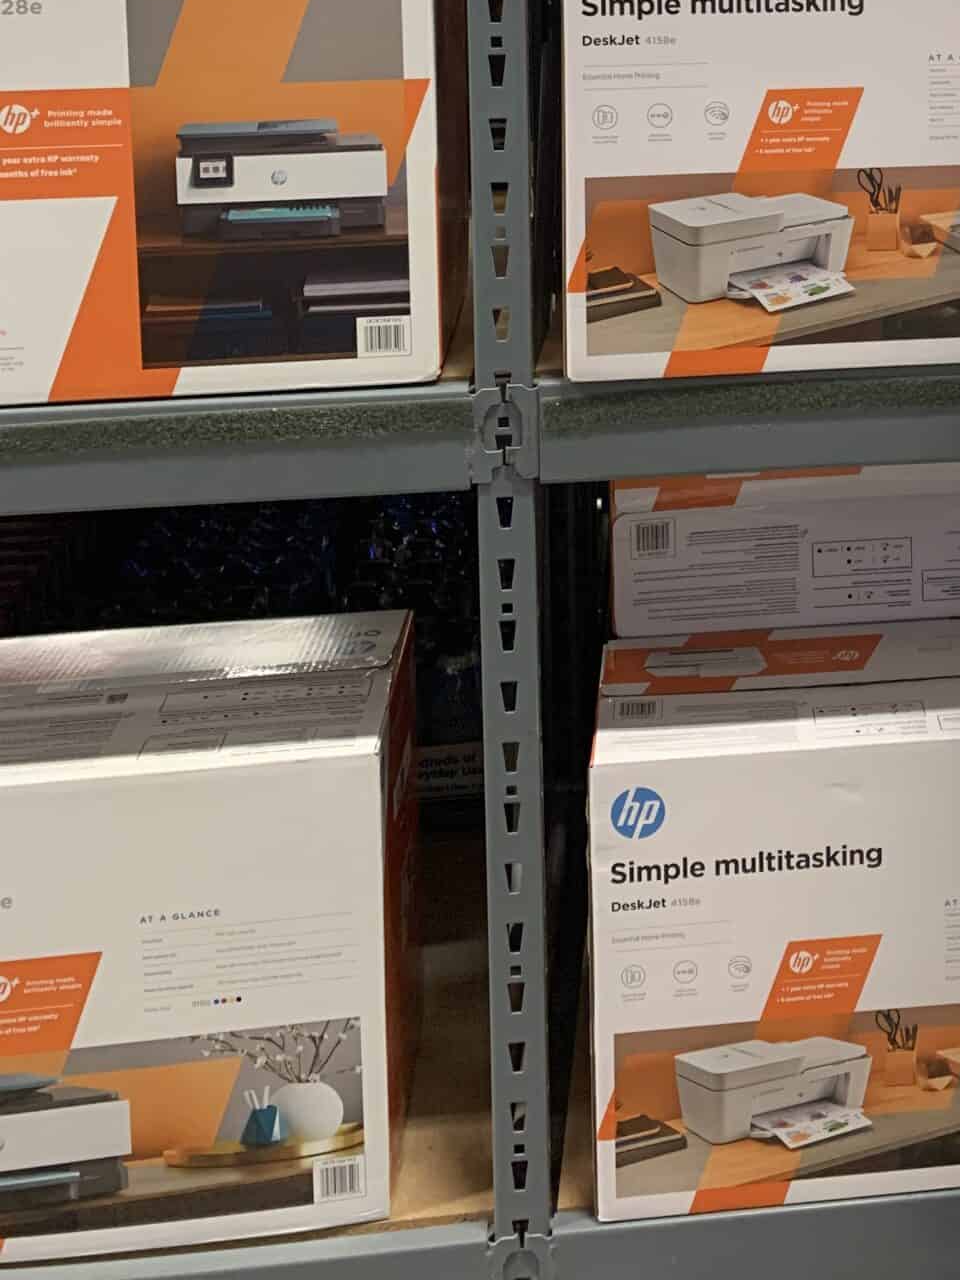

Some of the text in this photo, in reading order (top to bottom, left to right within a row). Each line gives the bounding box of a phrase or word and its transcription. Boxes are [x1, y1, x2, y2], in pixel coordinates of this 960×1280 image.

[582, 34, 640, 46] DeskJet
[928, 53, 942, 62] AT
[947, 53, 954, 61] A
[92, 118, 122, 127] simple
[60, 154, 99, 163] warranty
[610, 786, 667, 840] hp
[610, 845, 883, 885] Simple multitasking
[611, 898, 667, 912] DeskJet
[945, 899, 958, 907] AT
[140, 915, 153, 924] AT
[171, 908, 221, 921] GLANCE
